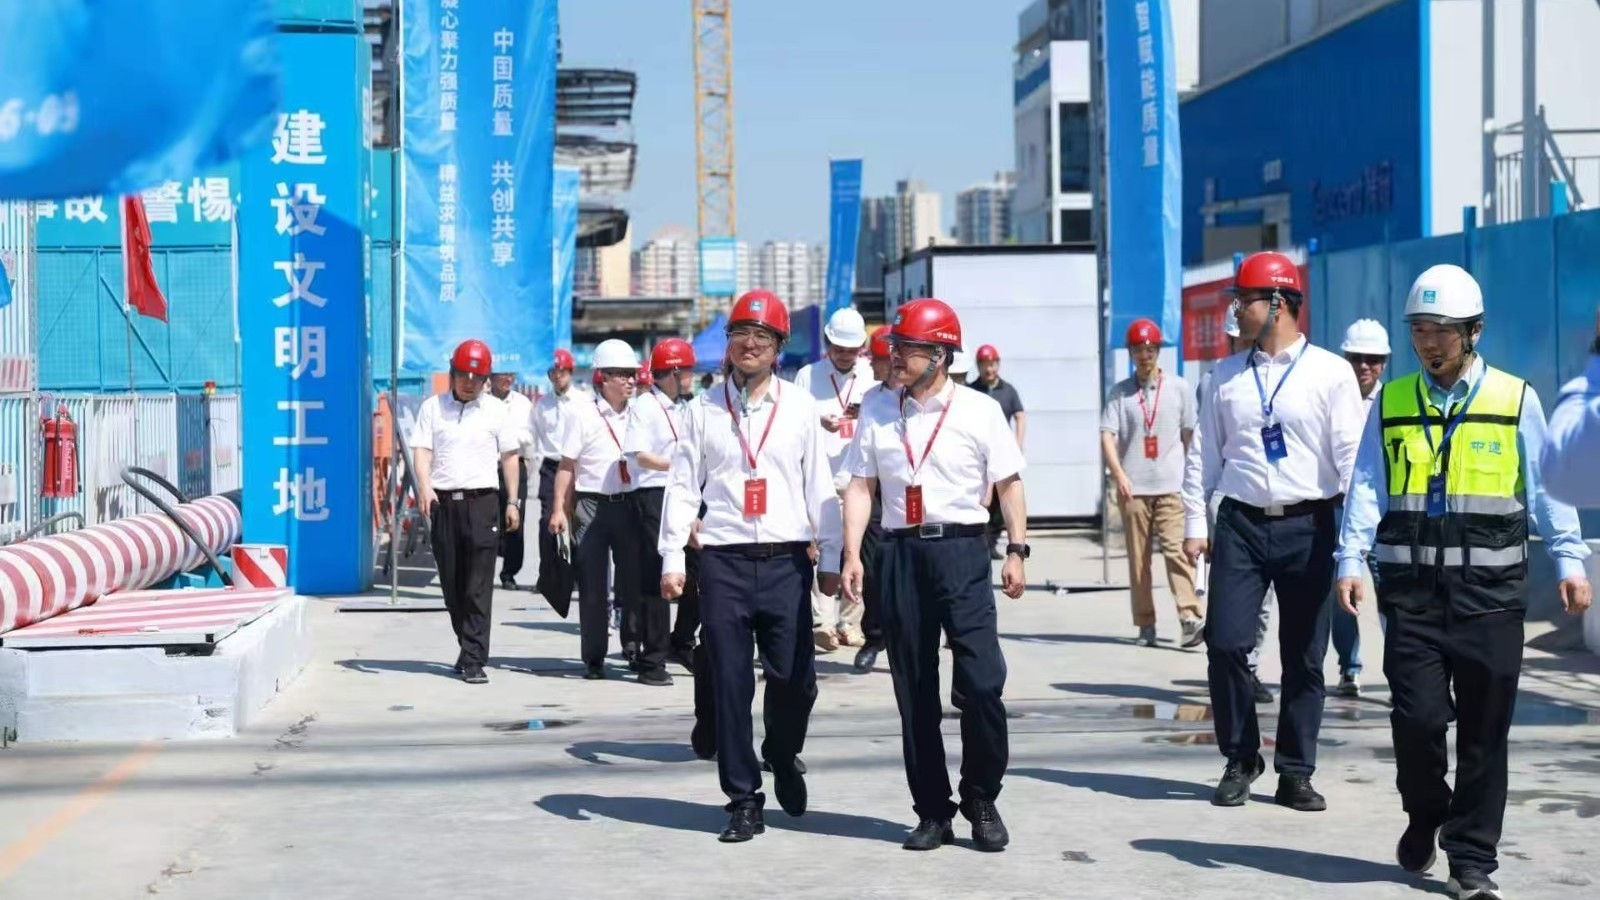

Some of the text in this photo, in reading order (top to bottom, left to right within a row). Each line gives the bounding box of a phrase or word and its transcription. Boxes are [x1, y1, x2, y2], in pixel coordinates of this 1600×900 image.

[142, 177, 240, 223] 警惕
[491, 27, 515, 267] 中国质量 共创共享
[270, 110, 329, 521] 建设文明工地
